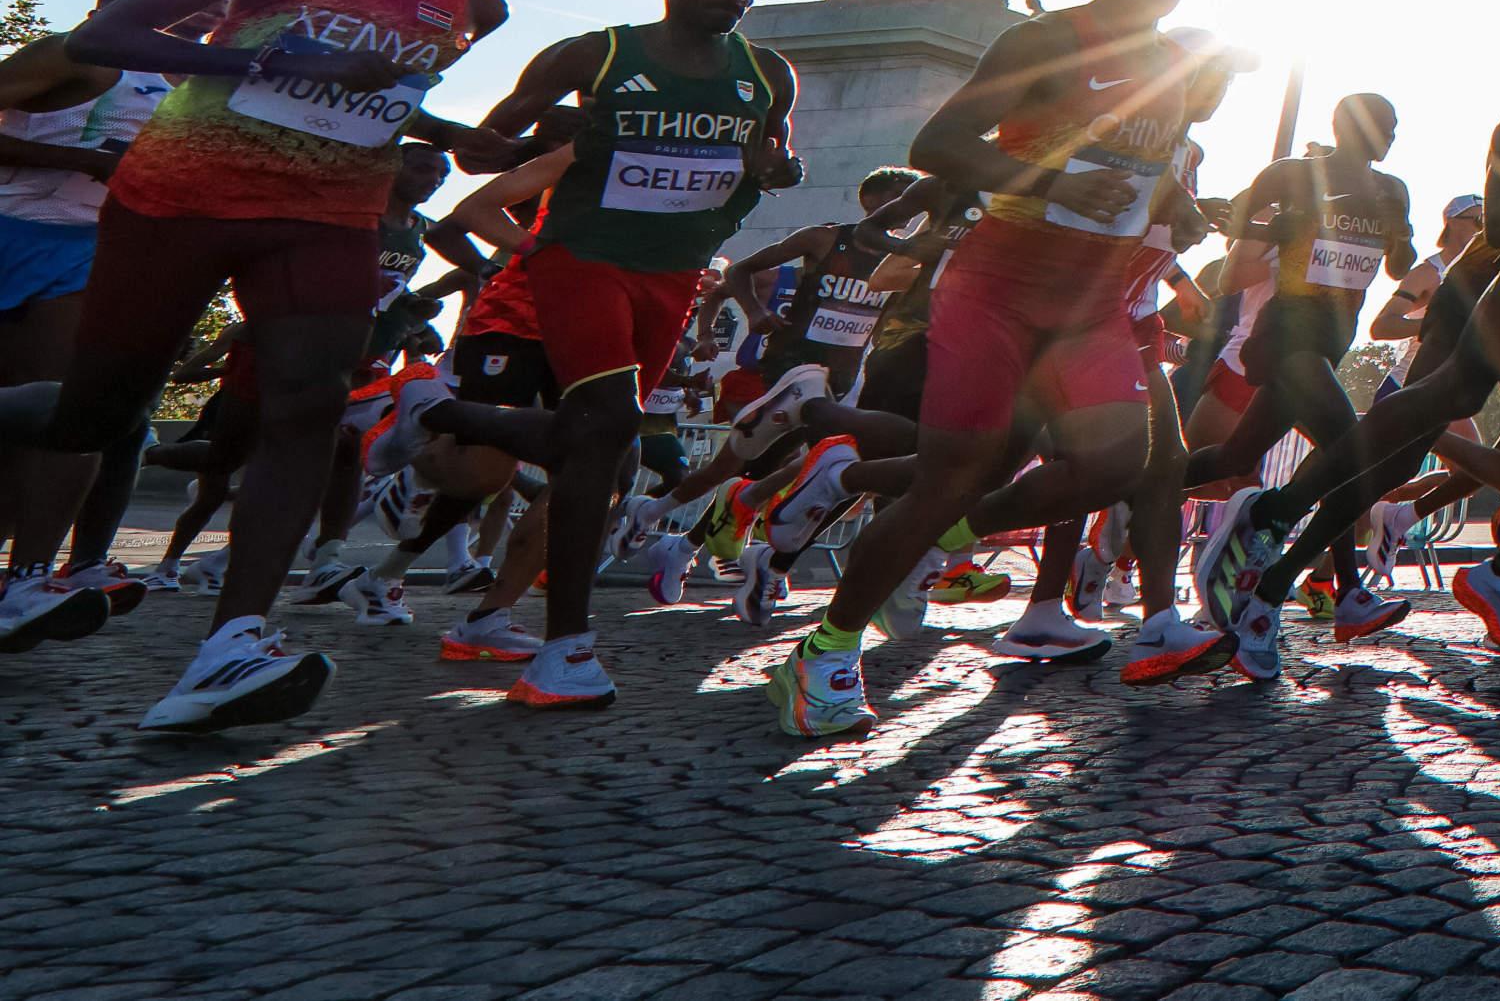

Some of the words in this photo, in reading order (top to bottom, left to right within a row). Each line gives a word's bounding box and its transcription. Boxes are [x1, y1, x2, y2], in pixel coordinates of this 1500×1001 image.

[287, 5, 439, 69] KENYA
[615, 110, 756, 143] ETHIOPIA
[618, 164, 736, 192] GELETA
